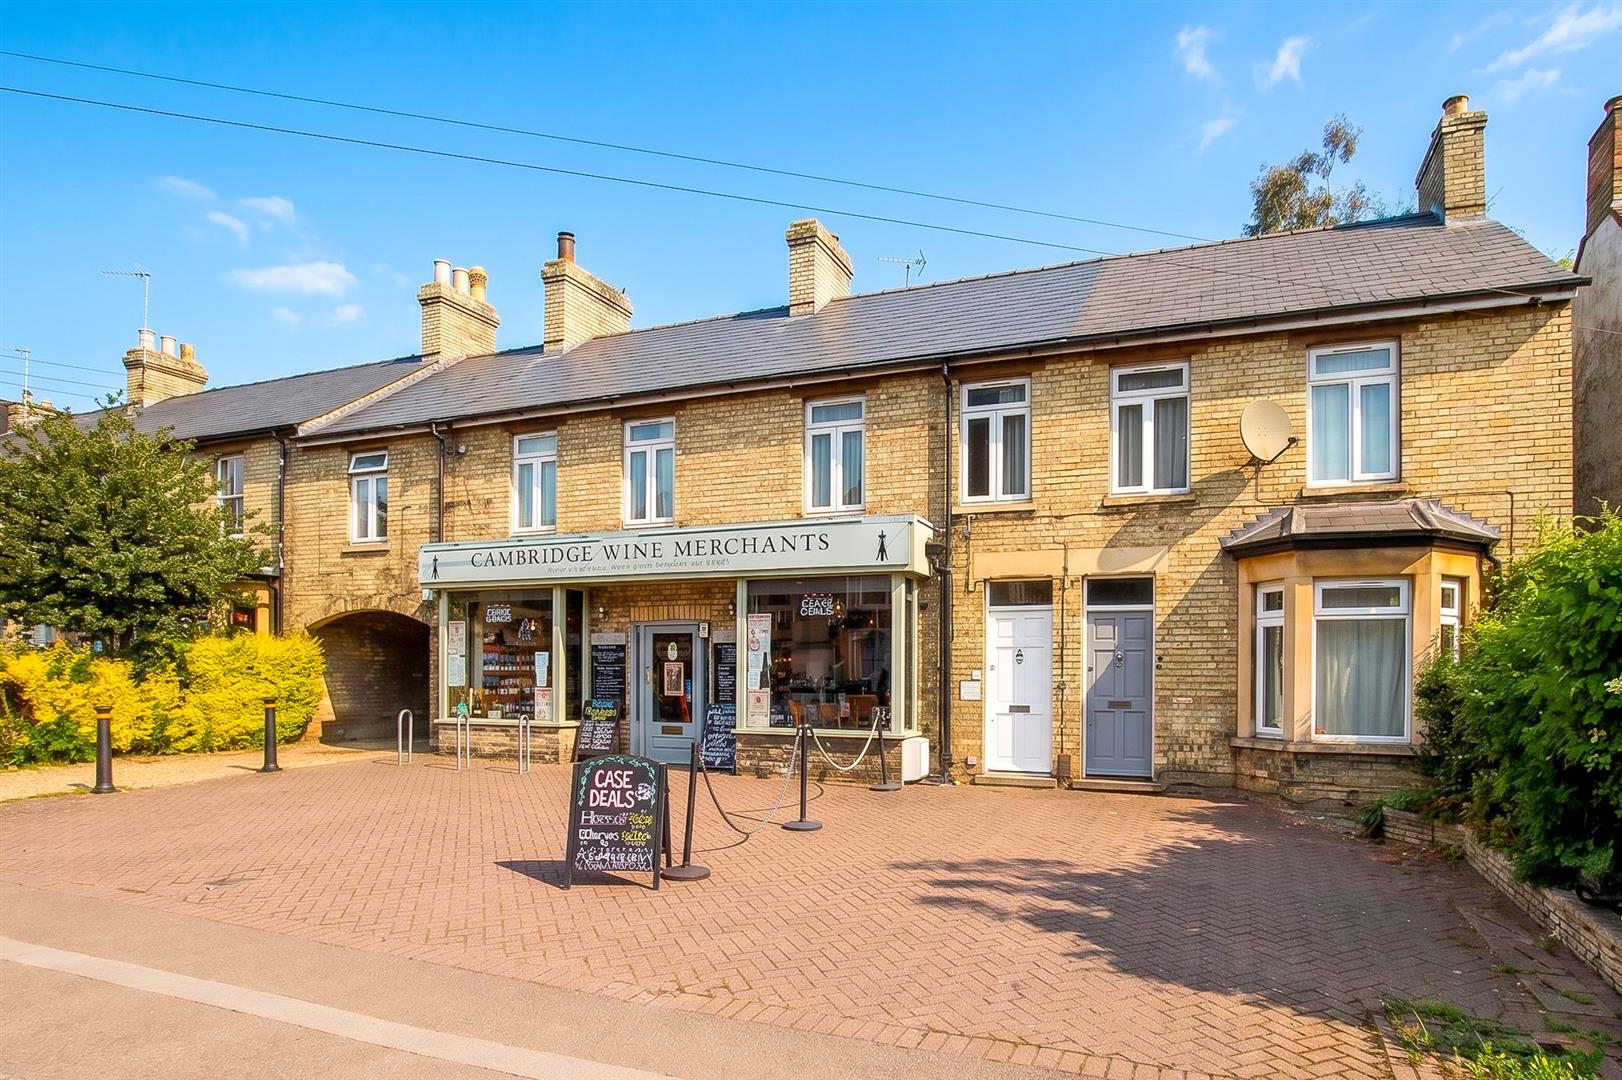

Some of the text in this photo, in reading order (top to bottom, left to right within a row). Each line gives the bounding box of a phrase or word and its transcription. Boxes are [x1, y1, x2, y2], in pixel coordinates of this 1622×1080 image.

[470, 545, 593, 568] CAMBRIDGE
[603, 541, 663, 561] WINE
[674, 533, 830, 557] MERCHANTS
[595, 769, 633, 789] CASE
[589, 789, 635, 809] DEALS
